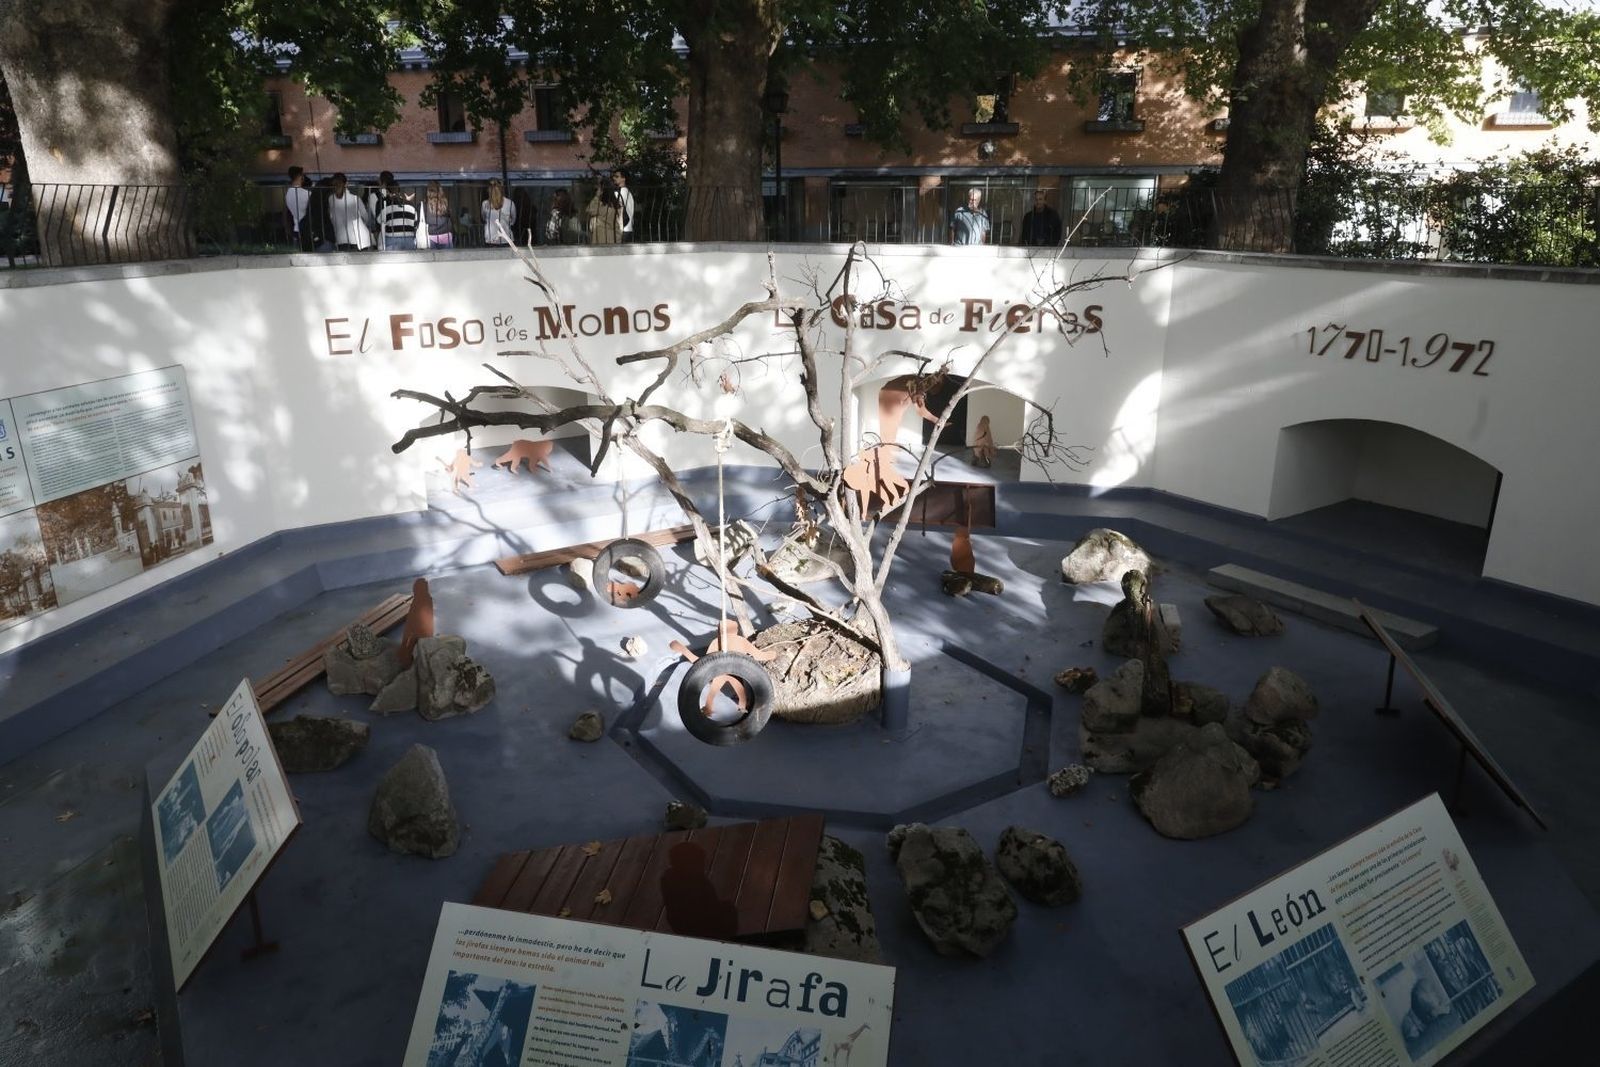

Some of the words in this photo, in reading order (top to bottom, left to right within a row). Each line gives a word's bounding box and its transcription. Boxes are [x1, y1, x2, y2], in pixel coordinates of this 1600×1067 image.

[325, 317, 372, 355] El
[389, 313, 484, 350] Foso
[493, 312, 514, 327] de
[533, 304, 671, 340] Monos
[831, 294, 922, 330] Casa
[929, 307, 955, 325] de
[959, 298, 1103, 334] Fieras
[1204, 924, 1240, 973] El
[1247, 889, 1326, 947] León
[640, 948, 687, 993] La
[696, 957, 848, 1018] Jirafa
